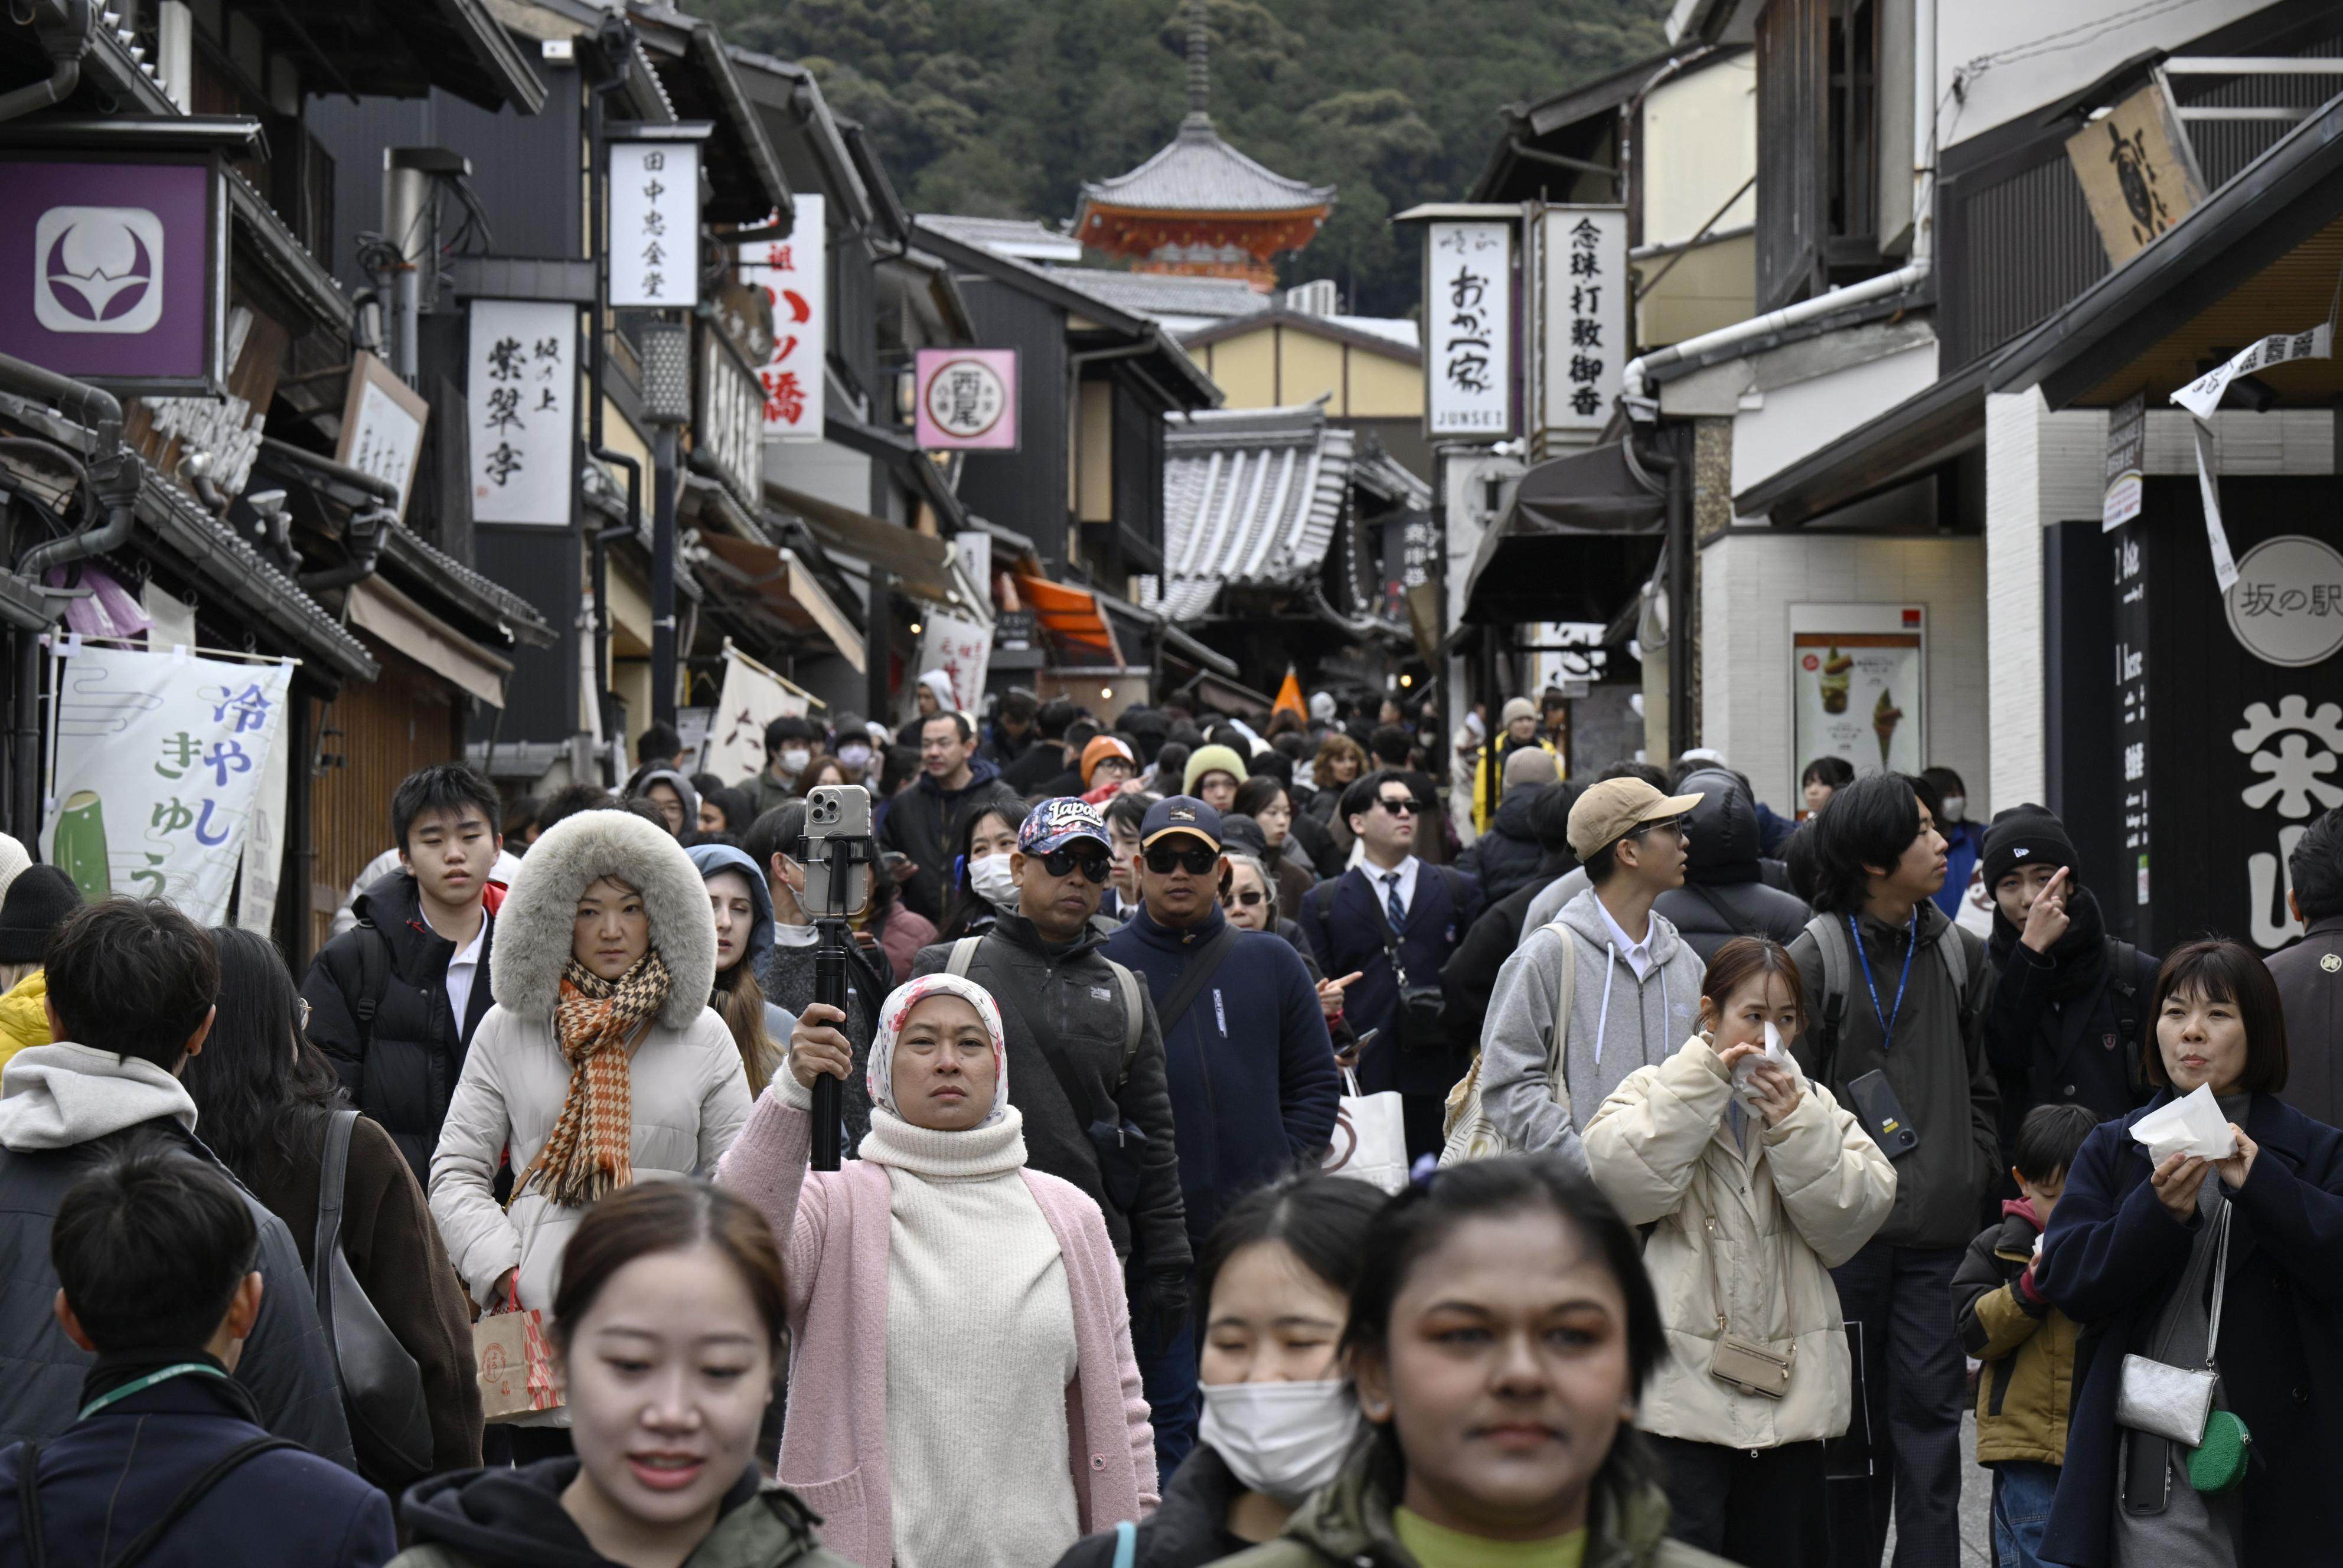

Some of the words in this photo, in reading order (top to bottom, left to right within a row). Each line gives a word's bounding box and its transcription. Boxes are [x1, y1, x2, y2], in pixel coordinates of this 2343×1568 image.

[1447, 264, 1493, 395] おかべ家
[2240, 582, 2343, 618] 坂の駅
[195, 684, 273, 847] 冷やし
[1048, 801, 1103, 827] Japan
